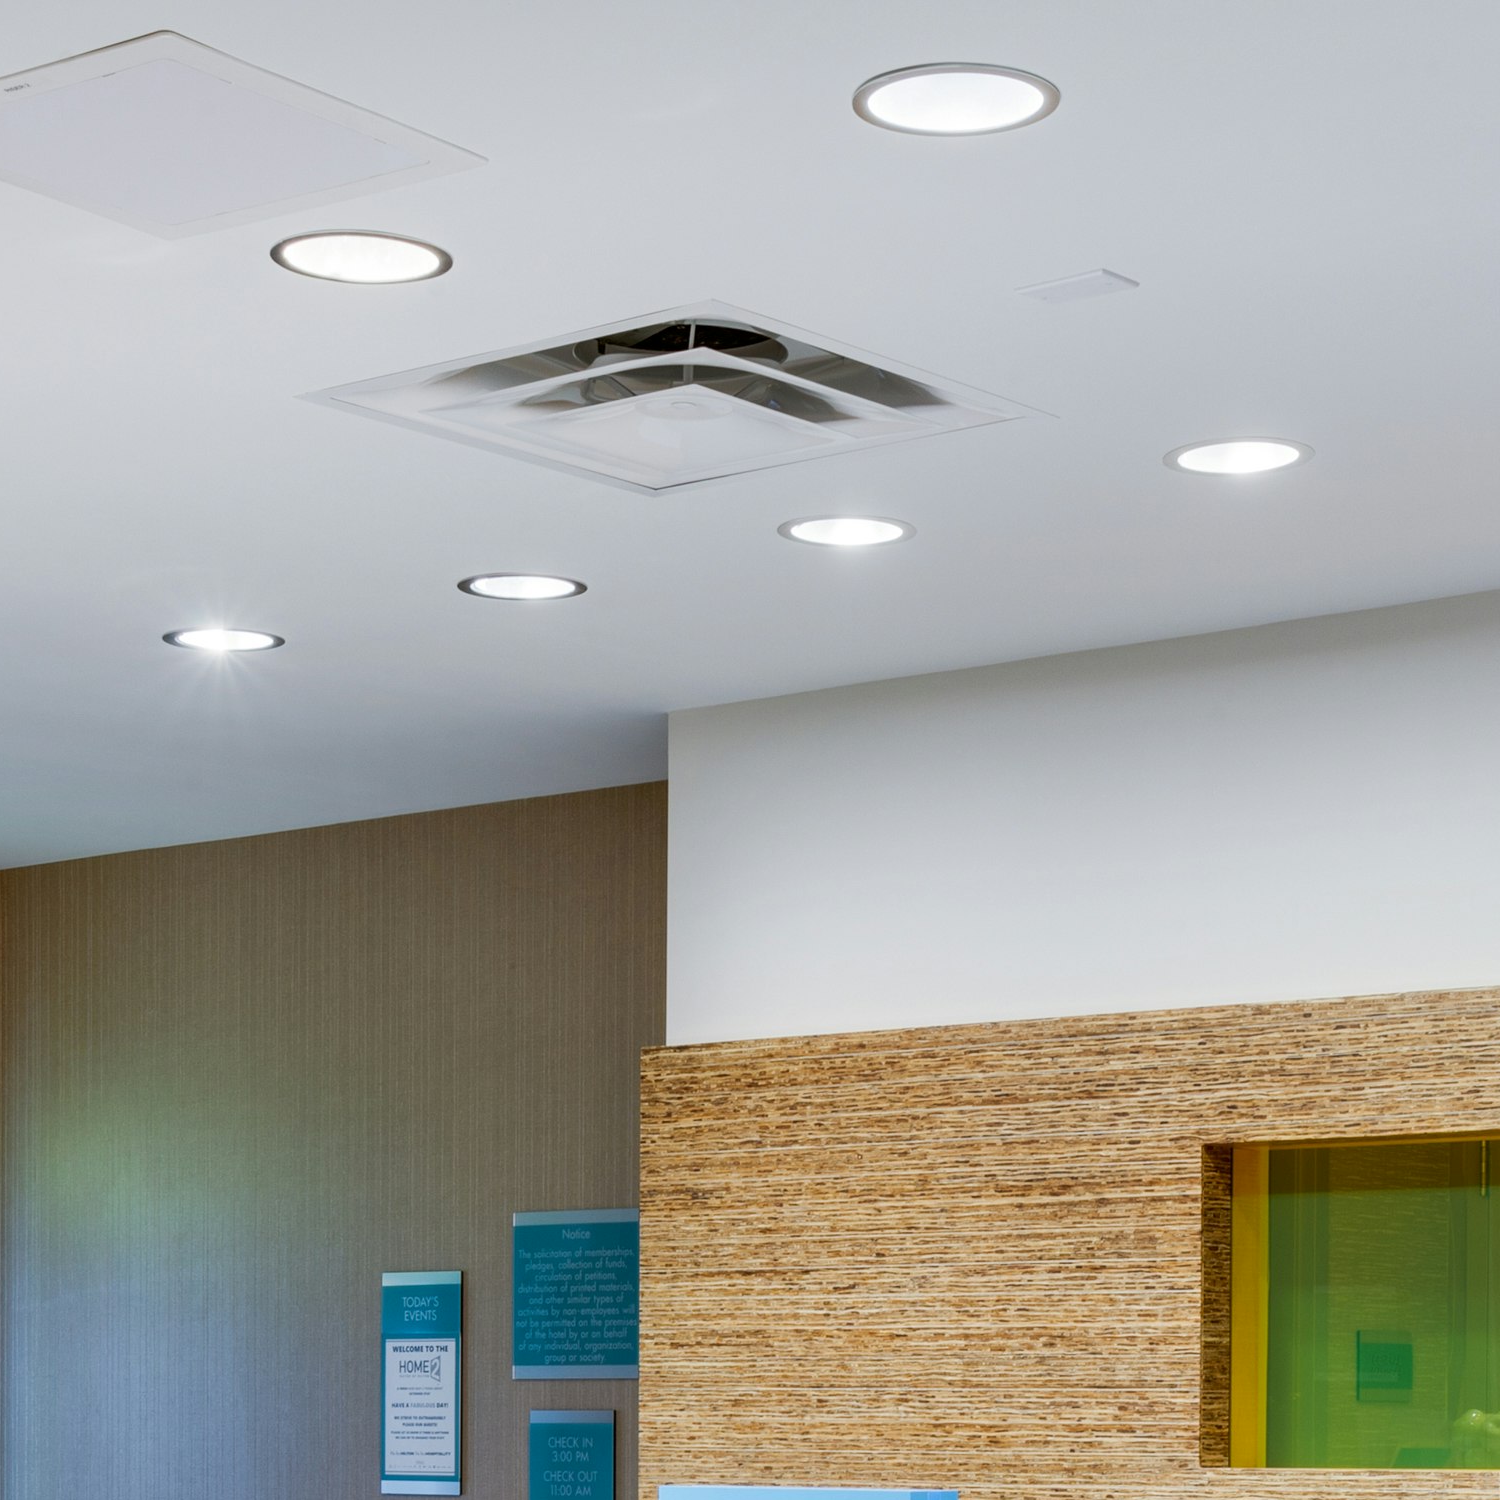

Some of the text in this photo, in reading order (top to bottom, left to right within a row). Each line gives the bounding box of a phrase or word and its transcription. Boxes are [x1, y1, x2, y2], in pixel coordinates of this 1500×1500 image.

[561, 1228, 592, 1241] Notice
[401, 1295, 440, 1308] TODAY'S
[404, 1309, 438, 1322] EVENTS
[392, 1344, 449, 1353] WELCOME TO THE
[398, 1359, 430, 1374] HOME
[547, 1436, 594, 1449] CHECK IN
[551, 1450, 590, 1463] 3:00 PM
[543, 1470, 598, 1483] CHECK OUT
[575, 1485, 592, 1497] AM
